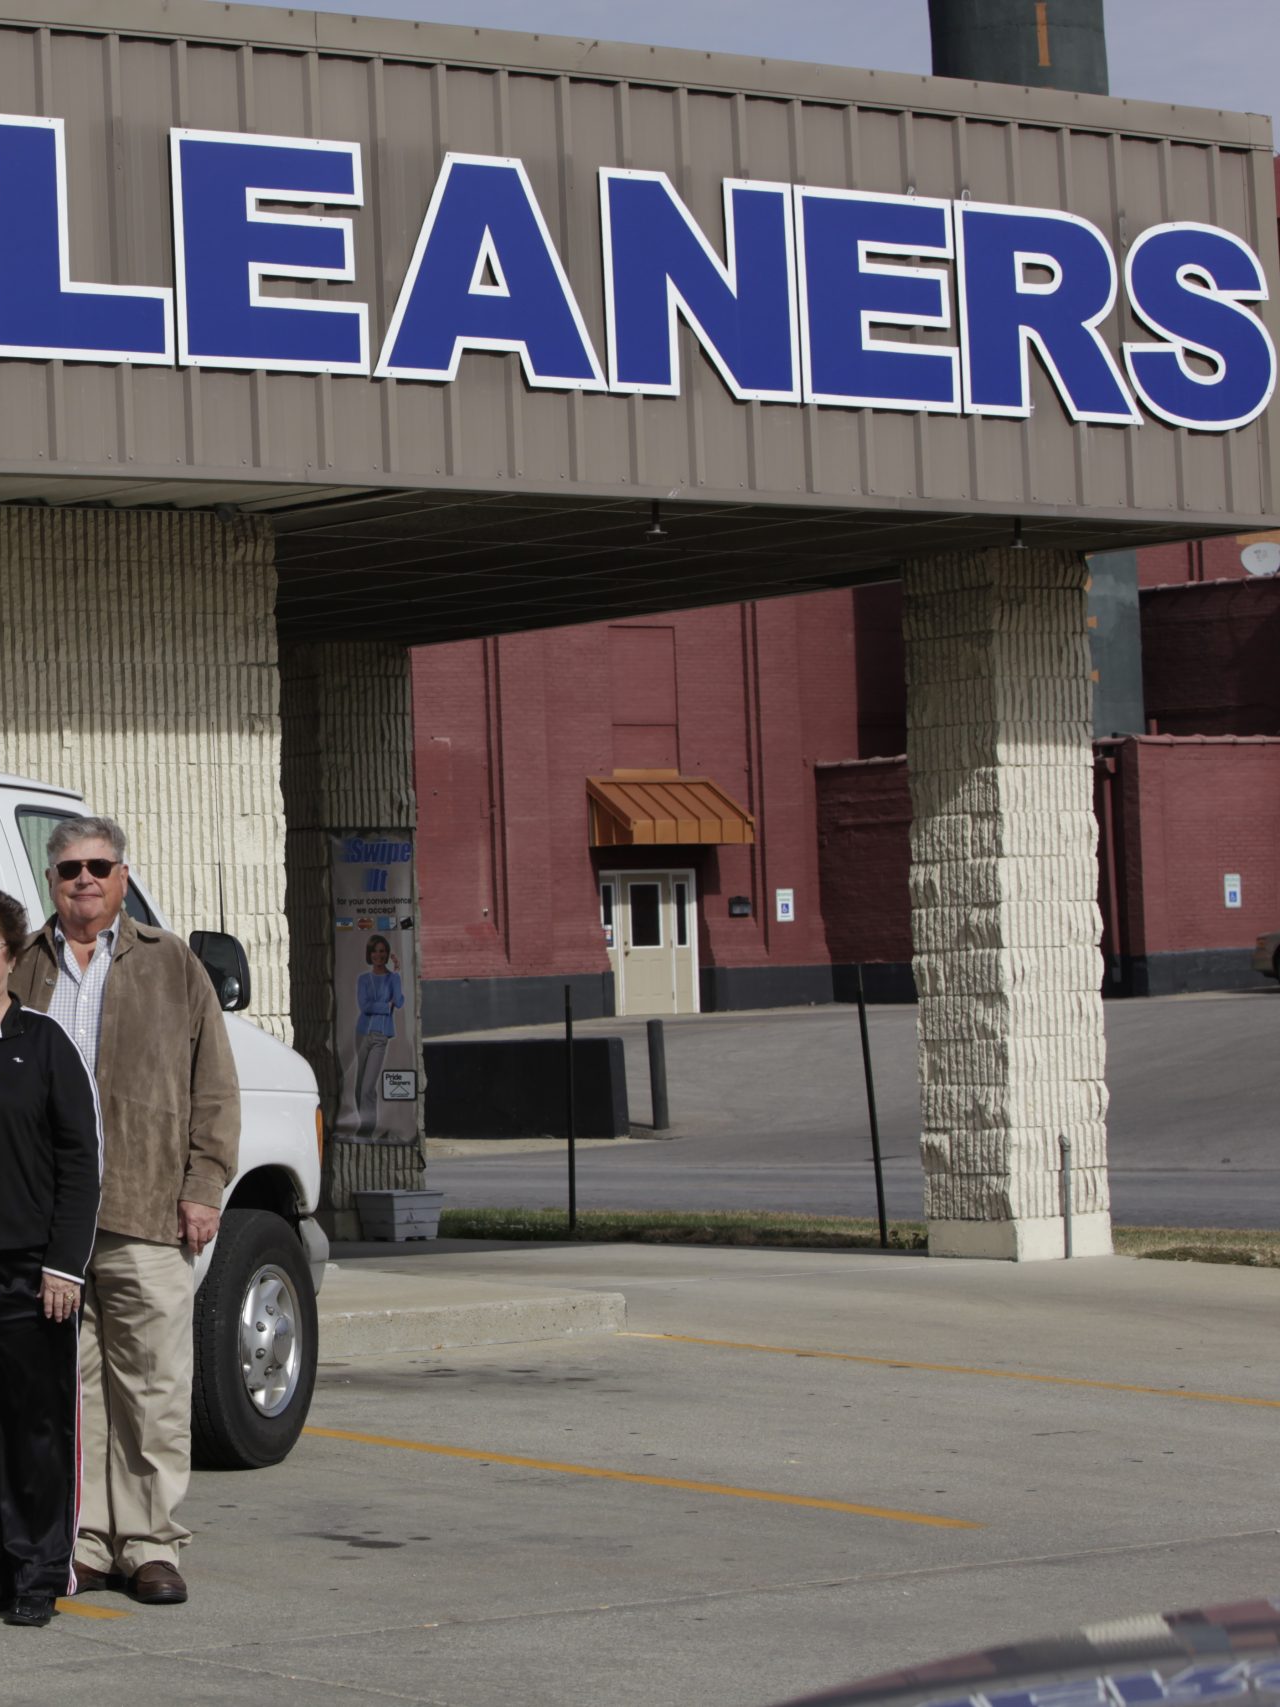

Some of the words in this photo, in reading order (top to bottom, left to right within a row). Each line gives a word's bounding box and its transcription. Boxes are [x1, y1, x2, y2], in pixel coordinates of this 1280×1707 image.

[347, 836, 412, 865] Swipe
[336, 896, 347, 905] for
[348, 898, 365, 907] your
[366, 896, 412, 905] convenience
[368, 905, 397, 915] accept
[385, 1073, 402, 1081] Pride
